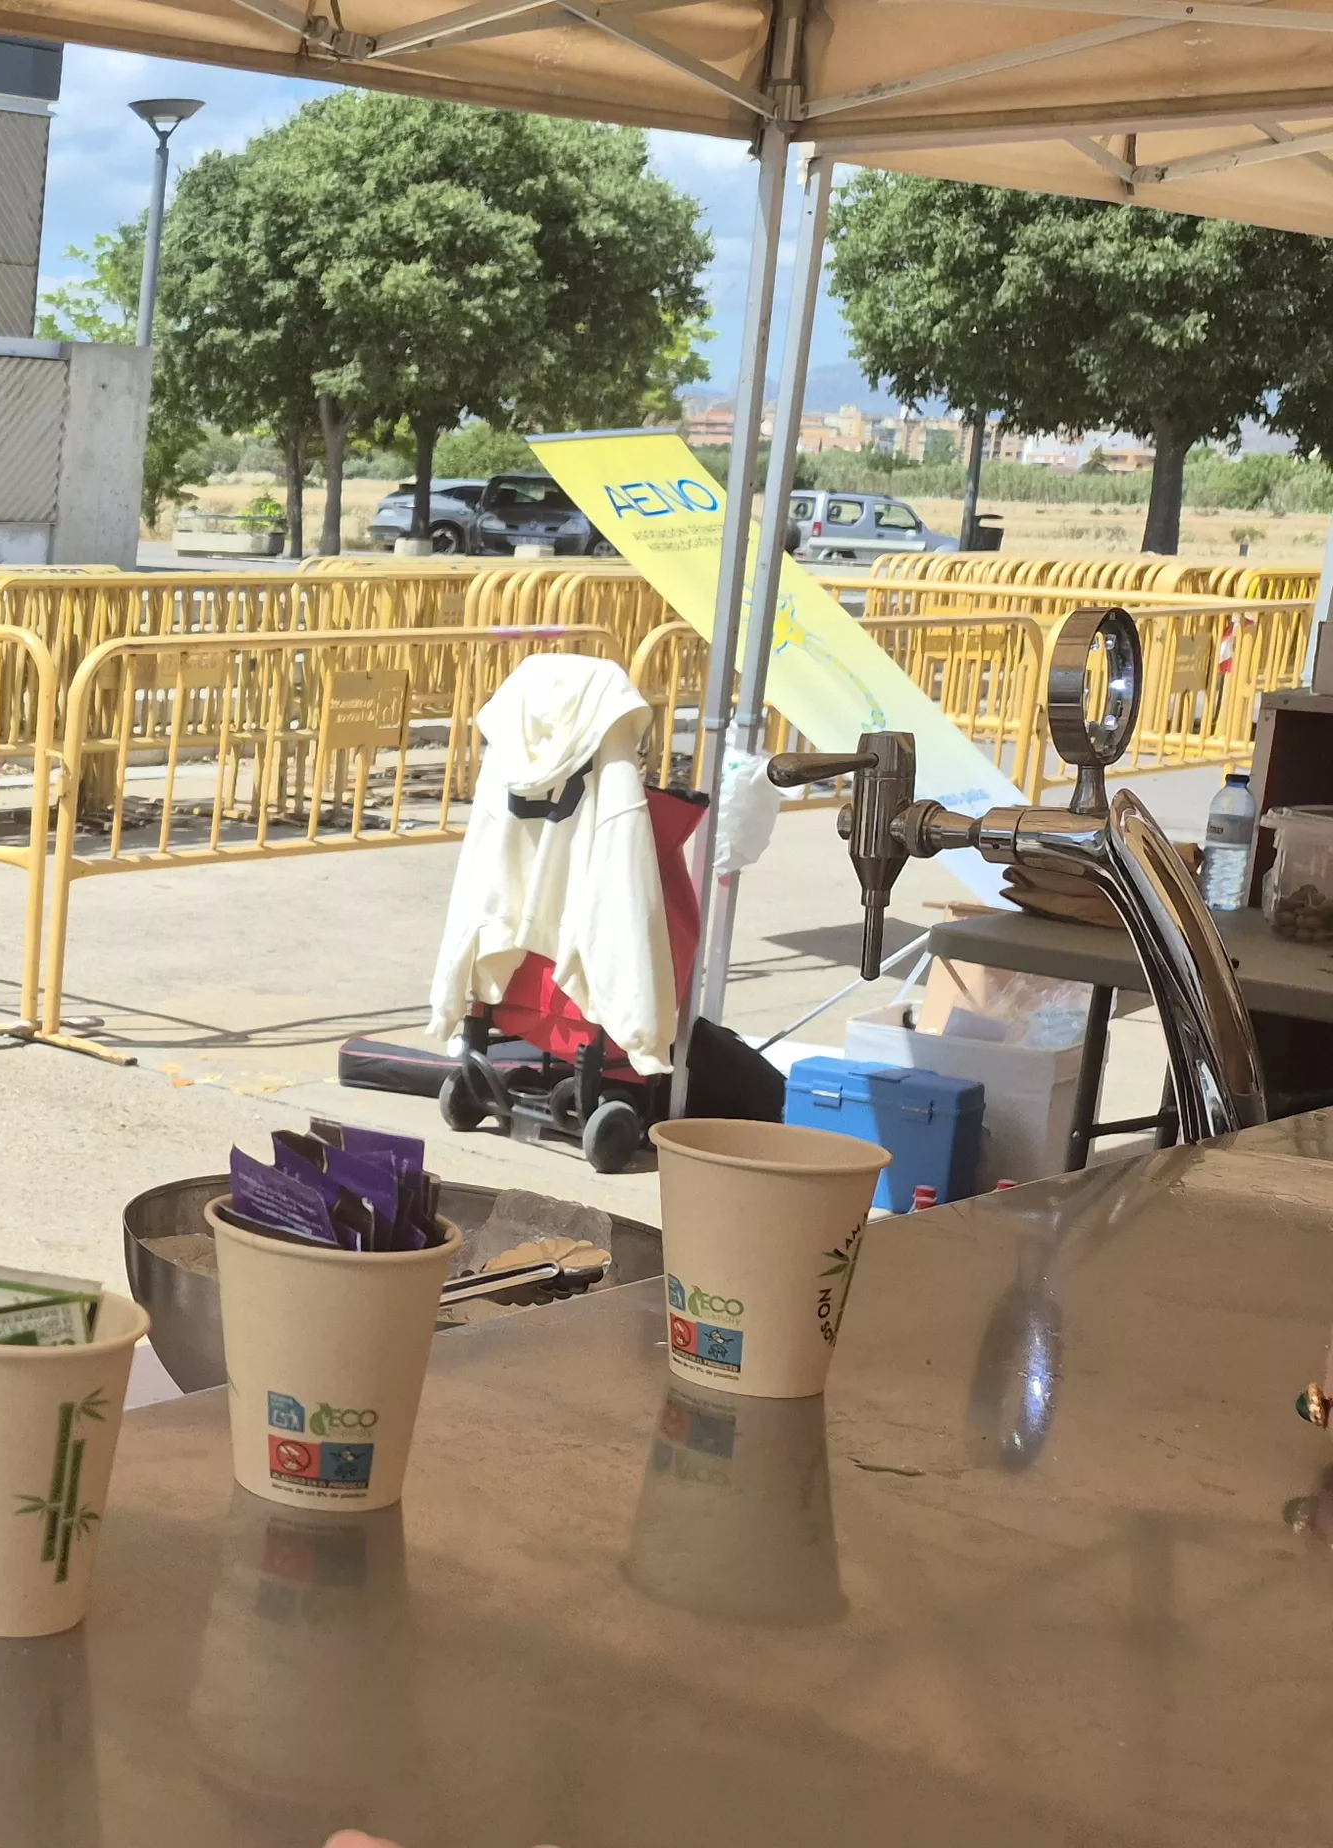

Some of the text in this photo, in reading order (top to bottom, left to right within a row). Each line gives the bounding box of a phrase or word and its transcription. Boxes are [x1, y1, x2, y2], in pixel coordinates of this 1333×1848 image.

[603, 479, 719, 519] AENO
[701, 1292, 744, 1316] ECO
[330, 1408, 378, 1428] ECO
